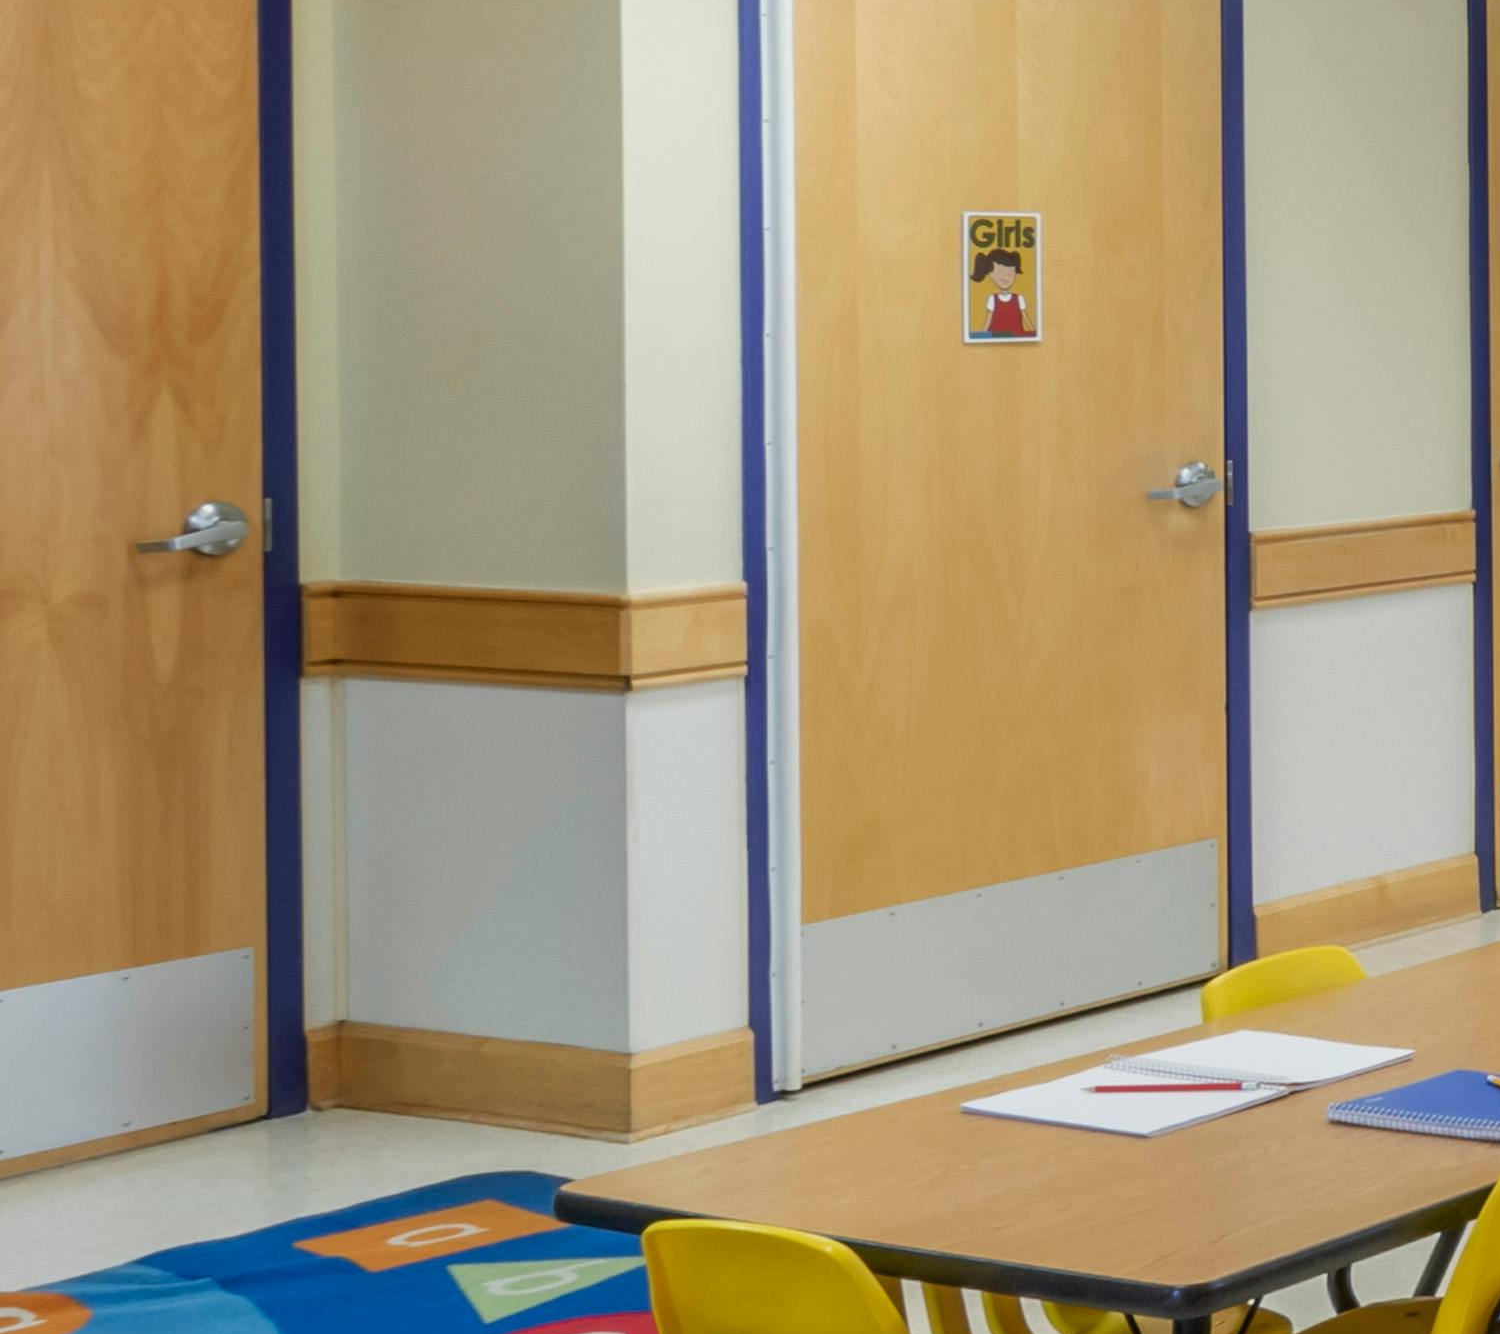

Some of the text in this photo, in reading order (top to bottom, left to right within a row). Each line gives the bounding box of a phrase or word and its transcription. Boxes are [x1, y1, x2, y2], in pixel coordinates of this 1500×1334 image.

[970, 219, 1036, 248] Girls
[387, 1222, 488, 1249] a
[481, 1258, 581, 1297] b
